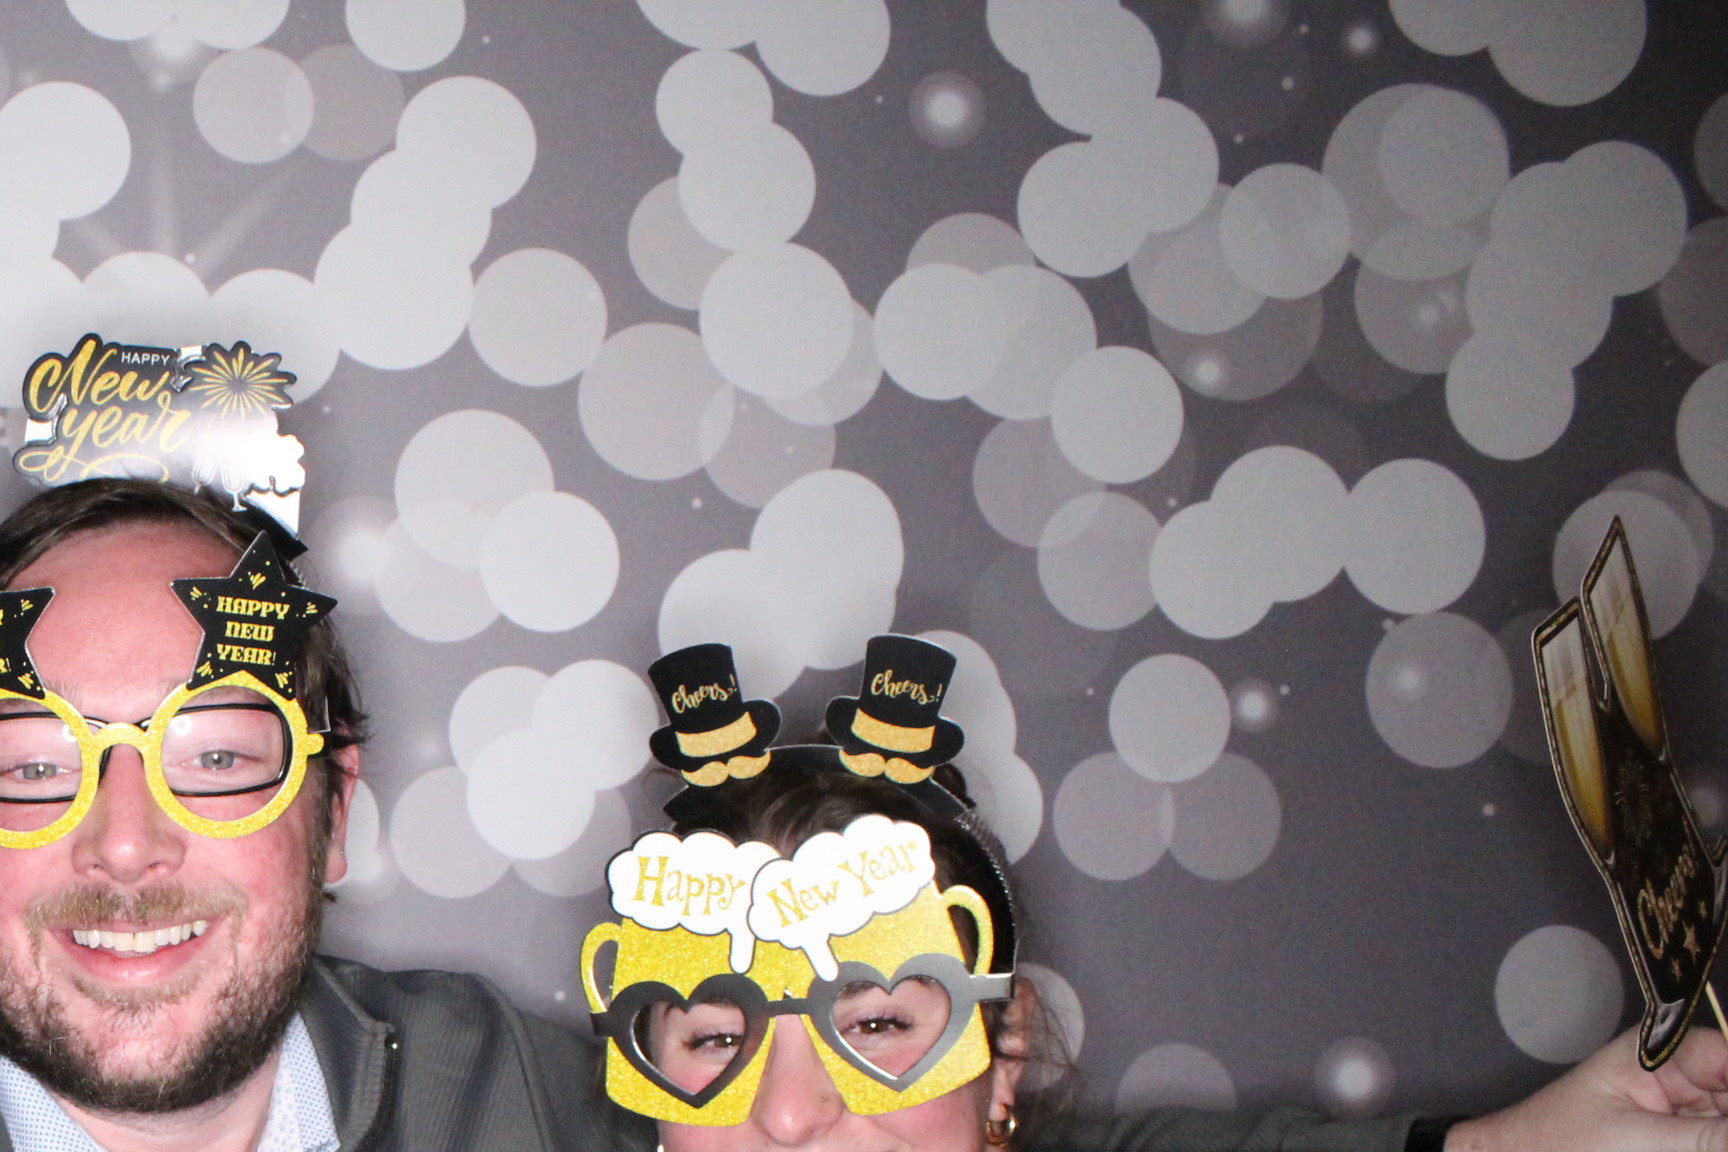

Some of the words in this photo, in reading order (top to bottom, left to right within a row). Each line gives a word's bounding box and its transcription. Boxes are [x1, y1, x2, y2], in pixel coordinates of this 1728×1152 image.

[29, 338, 171, 413] New
[121, 351, 171, 367] HAPPY
[215, 595, 291, 620] HAPPY
[225, 620, 276, 643] NEW
[215, 643, 277, 667] YEAR!
[671, 673, 738, 714] Cheers!
[870, 668, 944, 705] Cheers!
[631, 854, 747, 918] Happy
[765, 877, 841, 929] New
[837, 839, 919, 898] Year
